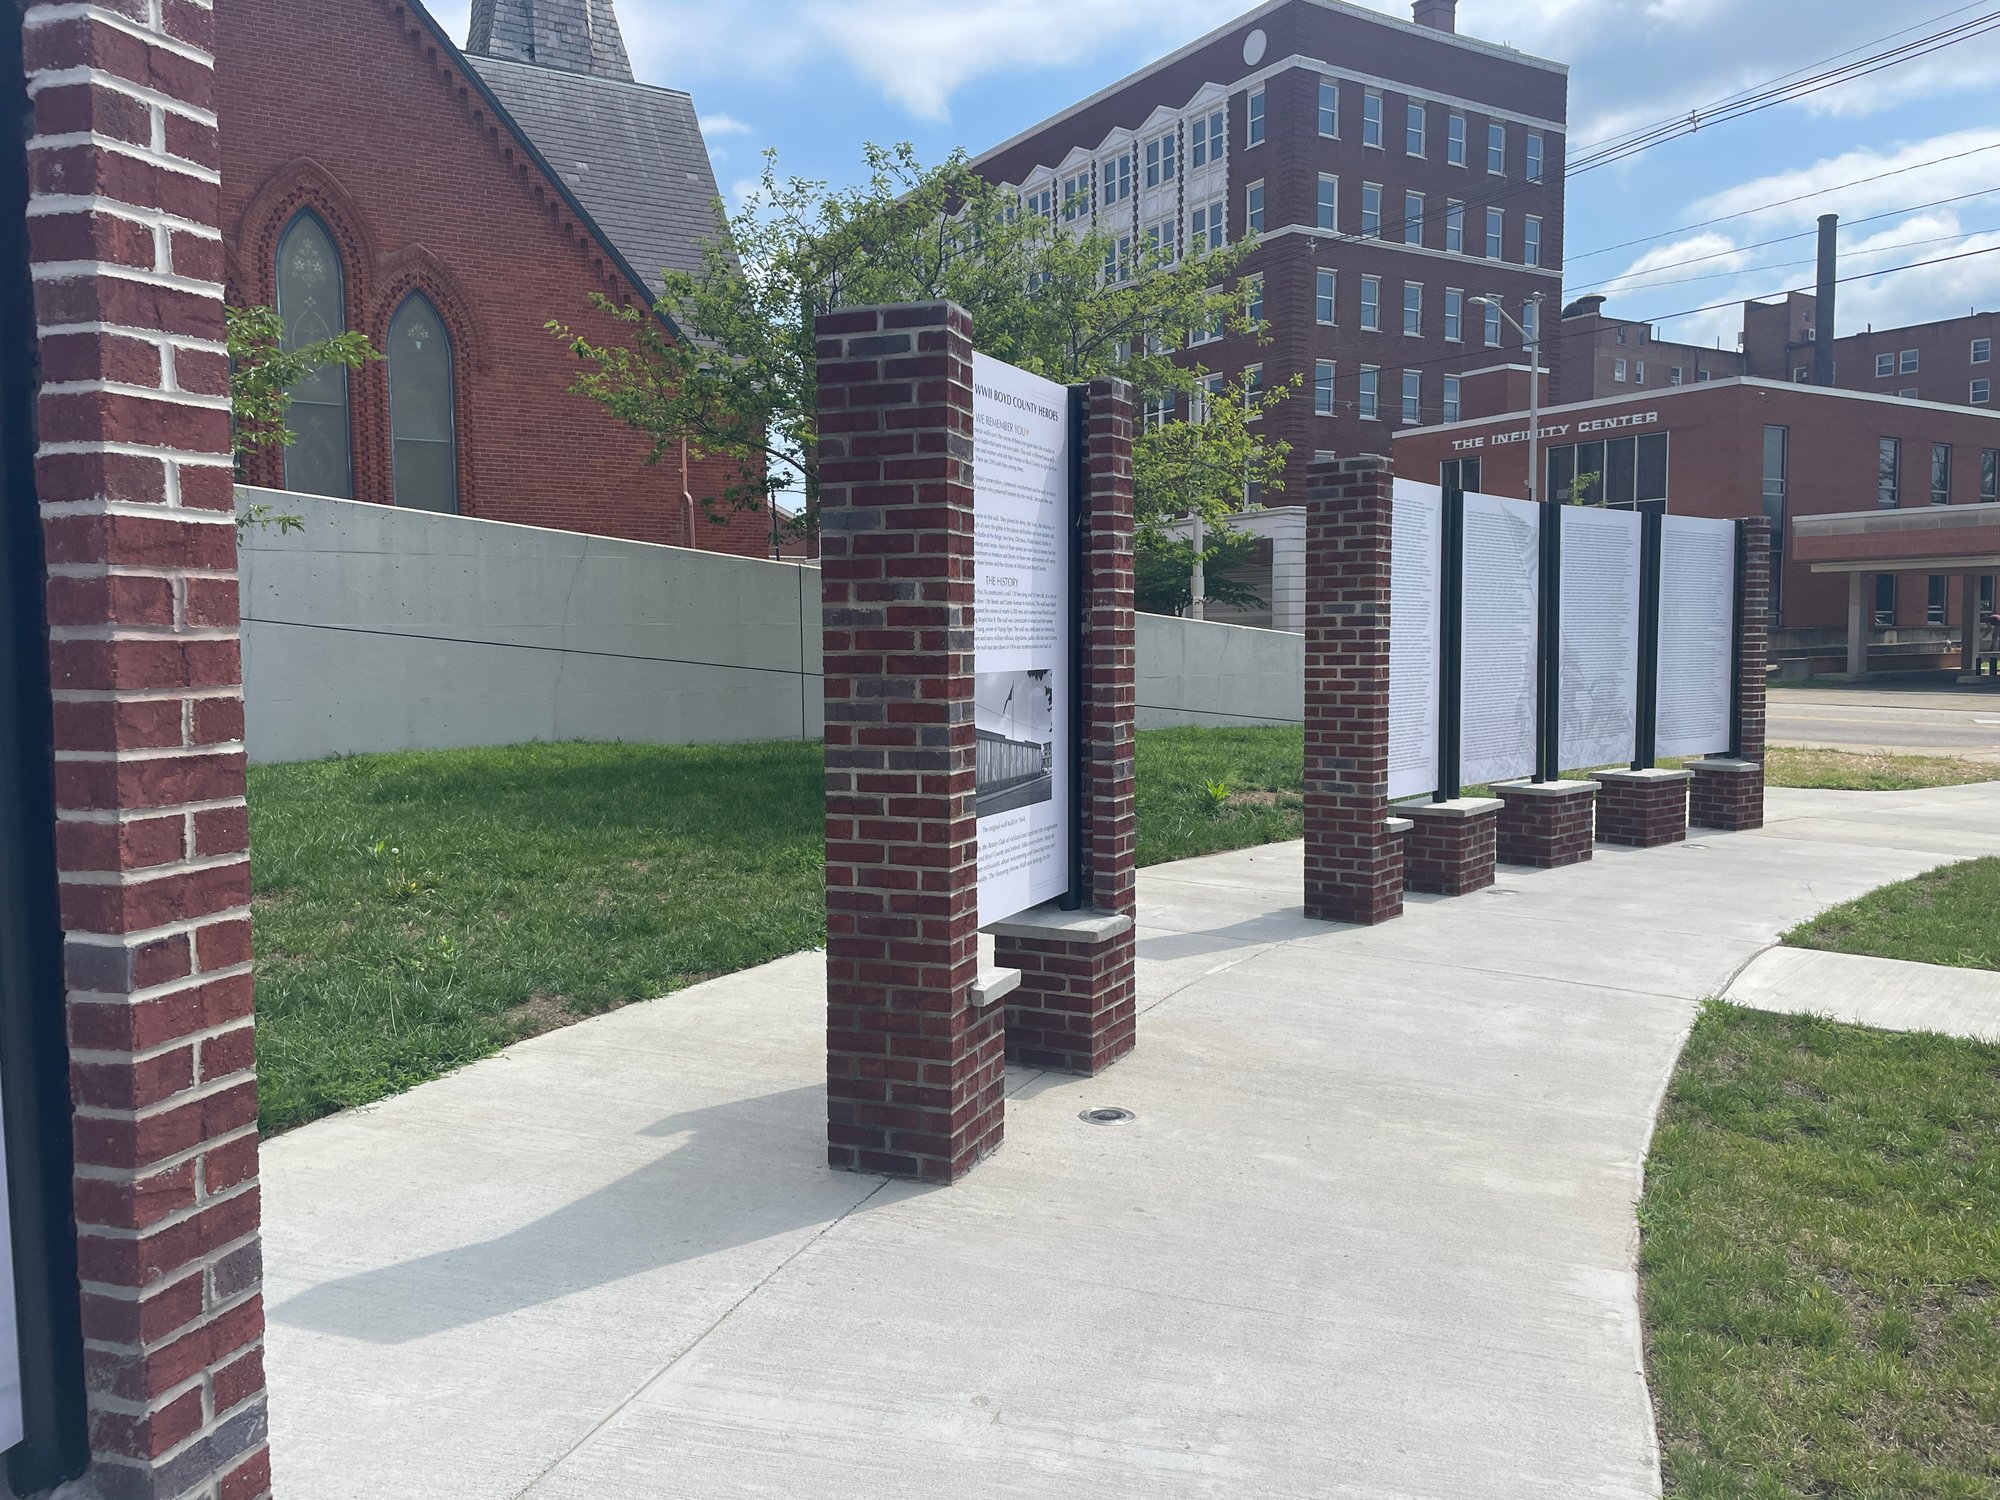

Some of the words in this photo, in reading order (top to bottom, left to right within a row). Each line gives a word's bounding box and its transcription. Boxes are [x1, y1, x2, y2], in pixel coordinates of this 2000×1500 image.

[975, 383, 992, 399] WWII
[994, 389, 1012, 406] BOYD
[1013, 396, 1037, 414] COUNTY
[1038, 405, 1059, 422] HEROES
[976, 412, 985, 425] WE
[985, 415, 1014, 433] REMEMBER
[1452, 436, 1485, 450] THE
[1578, 412, 1658, 433] CENTER
[985, 575, 996, 586] THE
[996, 577, 1018, 588] HISTORY
